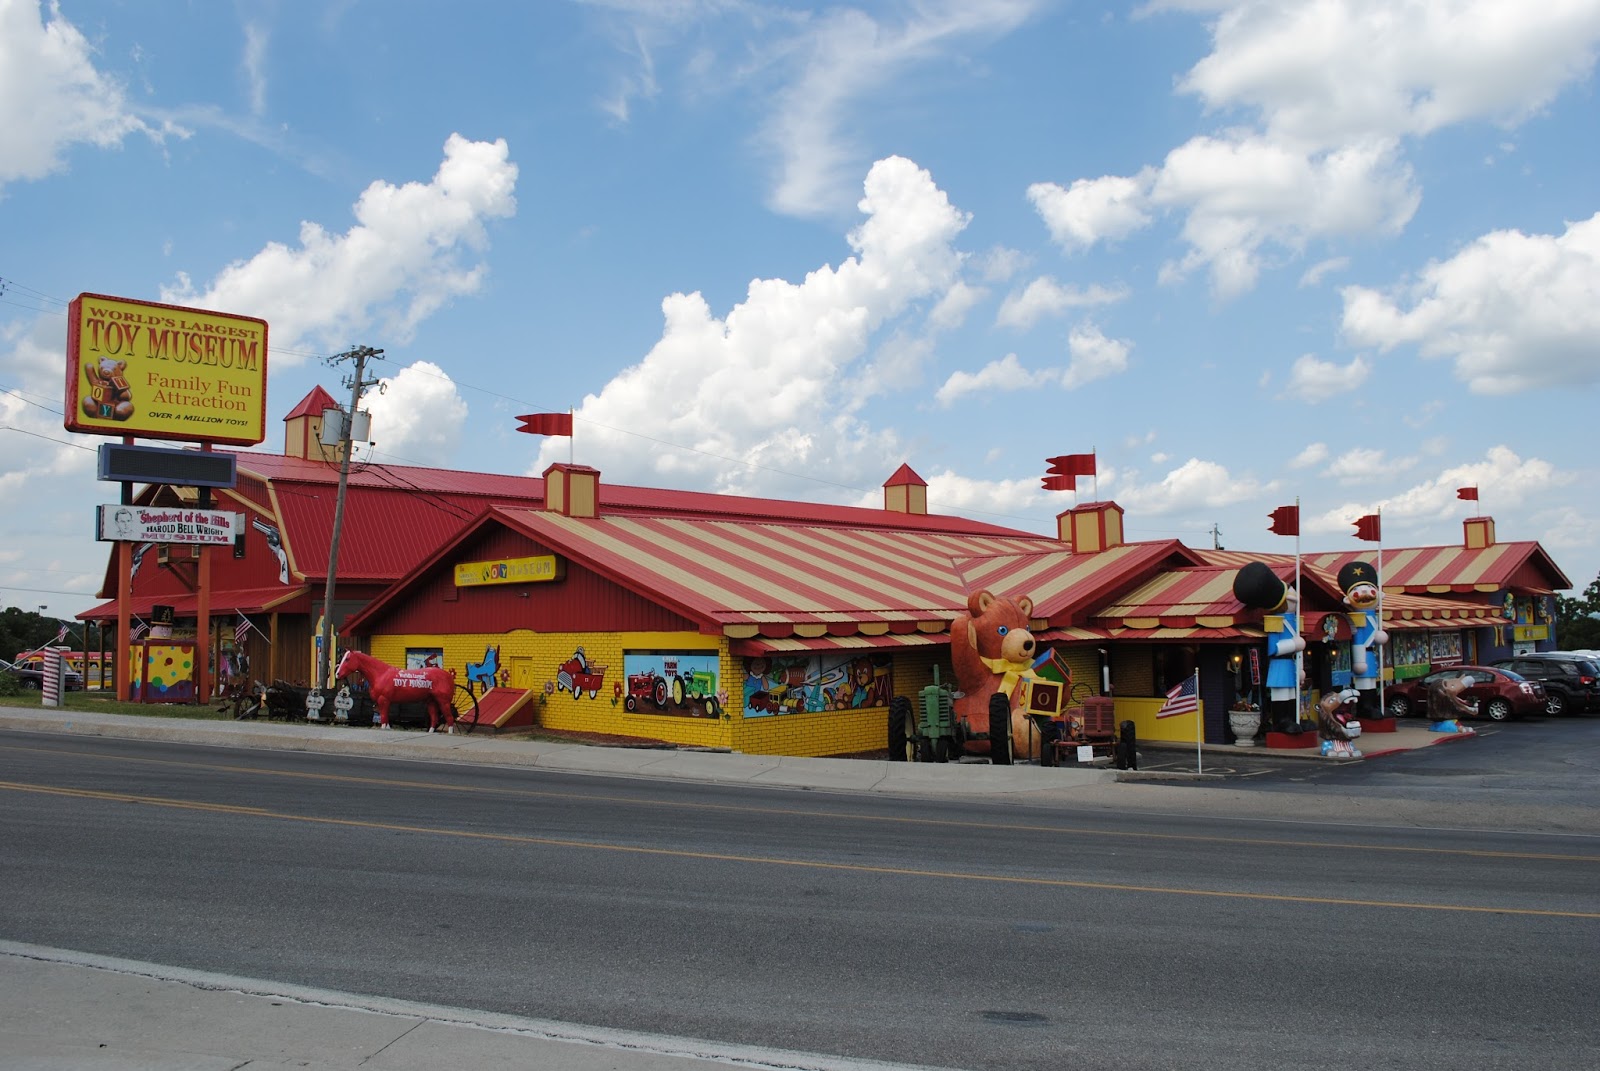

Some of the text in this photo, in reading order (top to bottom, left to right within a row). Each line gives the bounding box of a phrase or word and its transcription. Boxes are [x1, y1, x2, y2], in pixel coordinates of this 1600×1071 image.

[88, 306, 259, 339] WORLD'S LARGEST
[86, 317, 258, 371] TOY MUSEUM
[146, 371, 252, 397] Family Fun
[152, 389, 247, 412] Attraction
[148, 411, 173, 420] OVER
[183, 414, 224, 424] MILLION
[225, 418, 249, 427] TOYS!
[140, 510, 230, 529] Shepherd of the Hills
[146, 523, 224, 536] HAROLD BELL WRIGHT
[140, 532, 229, 543] MUSEUM
[664, 661, 678, 669] FARM
[1404, 666, 1421, 677] TOYS
[393, 679, 408, 688] TOY
[1037, 692, 1050, 706] O
